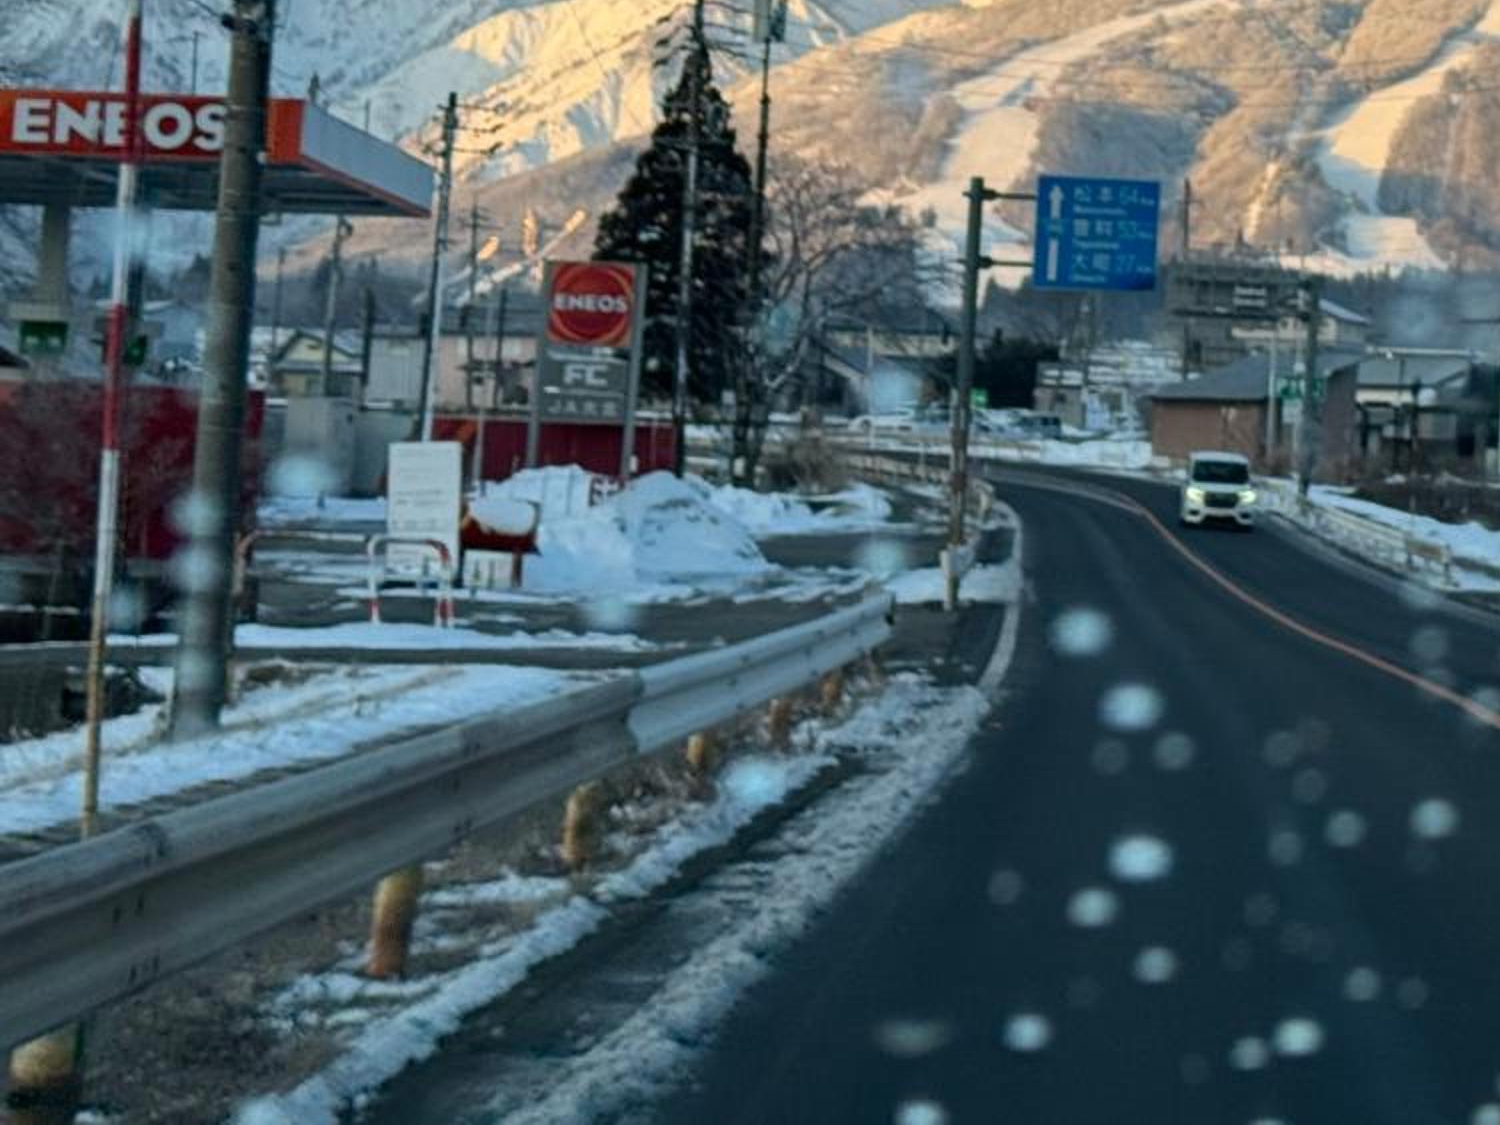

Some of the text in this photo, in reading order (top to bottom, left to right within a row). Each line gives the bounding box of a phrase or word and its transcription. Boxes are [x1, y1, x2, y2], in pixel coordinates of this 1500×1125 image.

[12, 98, 226, 151] ENEOS
[553, 293, 629, 313] ENEOS
[564, 364, 609, 387] FC
